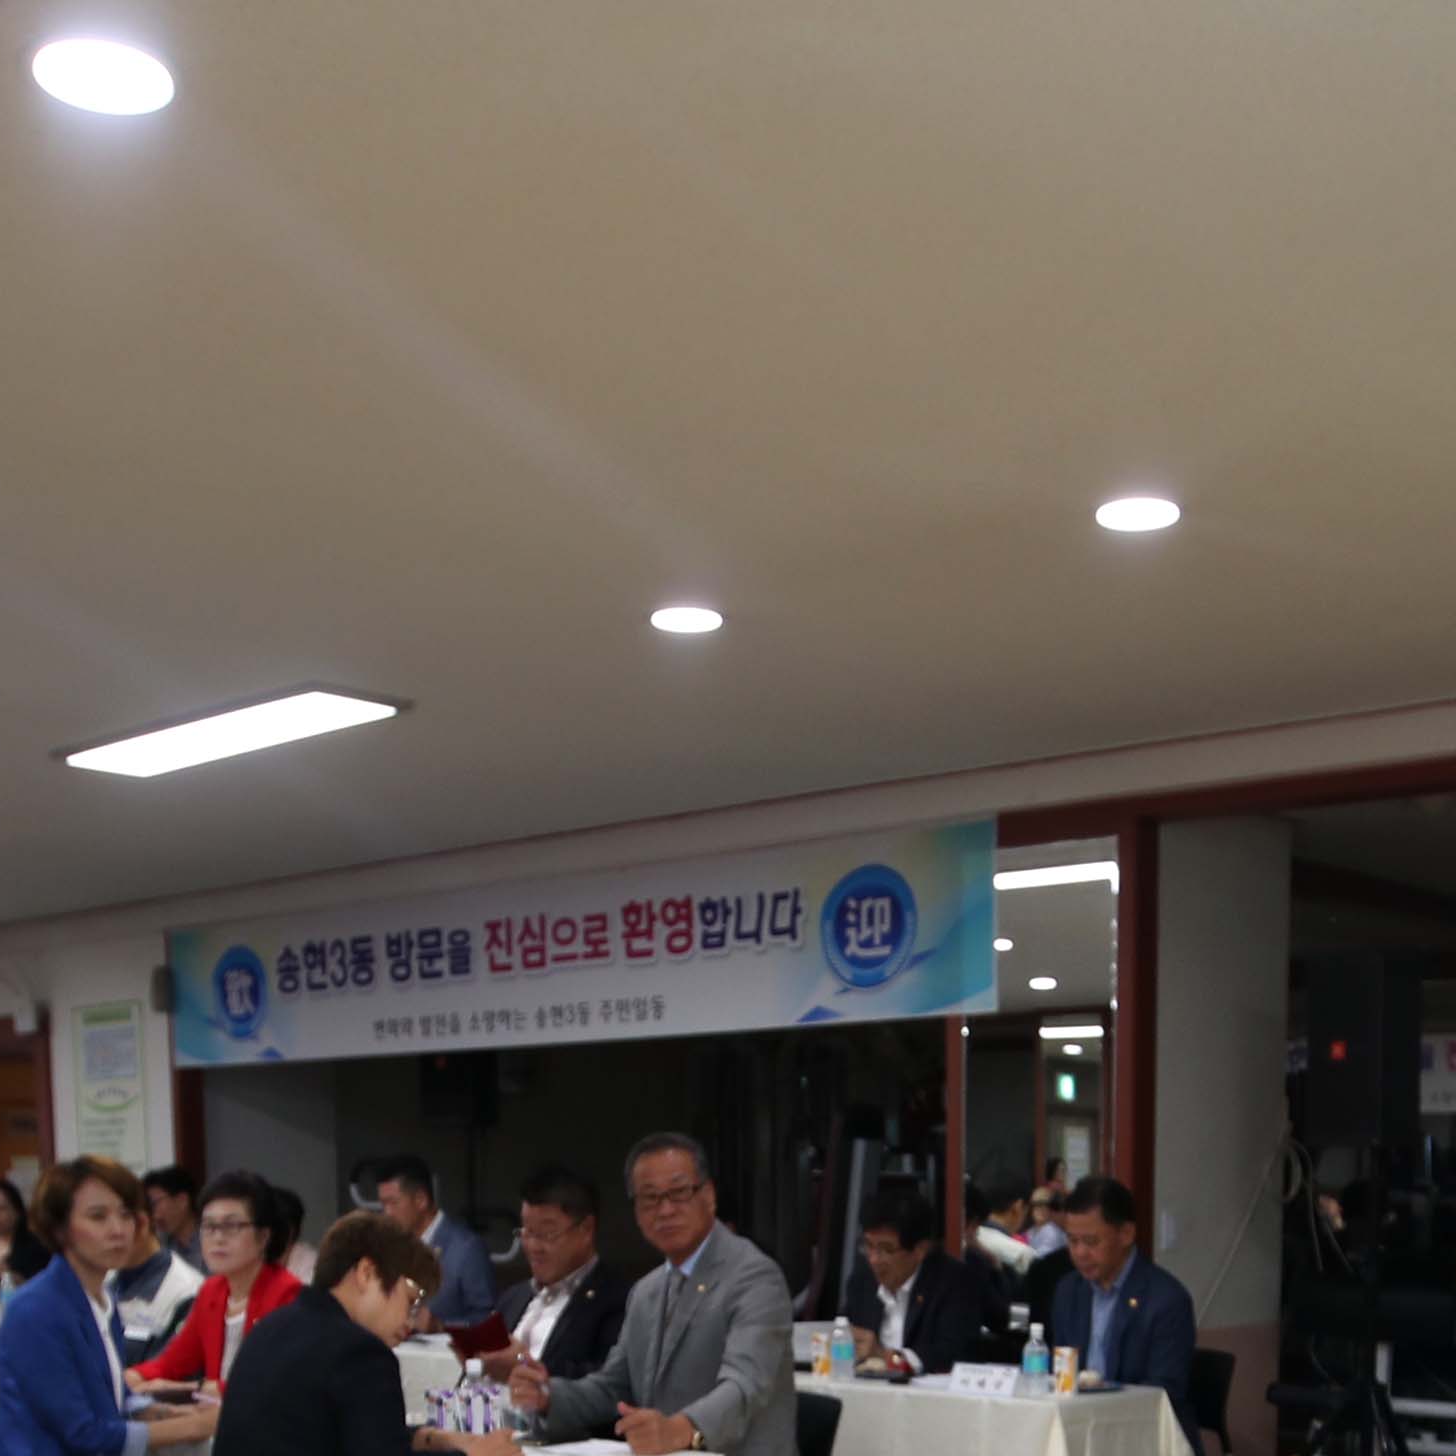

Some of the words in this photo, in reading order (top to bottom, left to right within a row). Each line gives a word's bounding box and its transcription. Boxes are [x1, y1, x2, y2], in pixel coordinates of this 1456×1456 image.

[276, 935, 376, 995] 송현3동
[385, 927, 472, 982] 방문을
[483, 911, 612, 974] 진심으로
[620, 887, 803, 960] 환영합니다
[844, 895, 893, 958] 迎
[533, 1000, 591, 1030] 송현3동
[599, 993, 666, 1024] 주민일동
